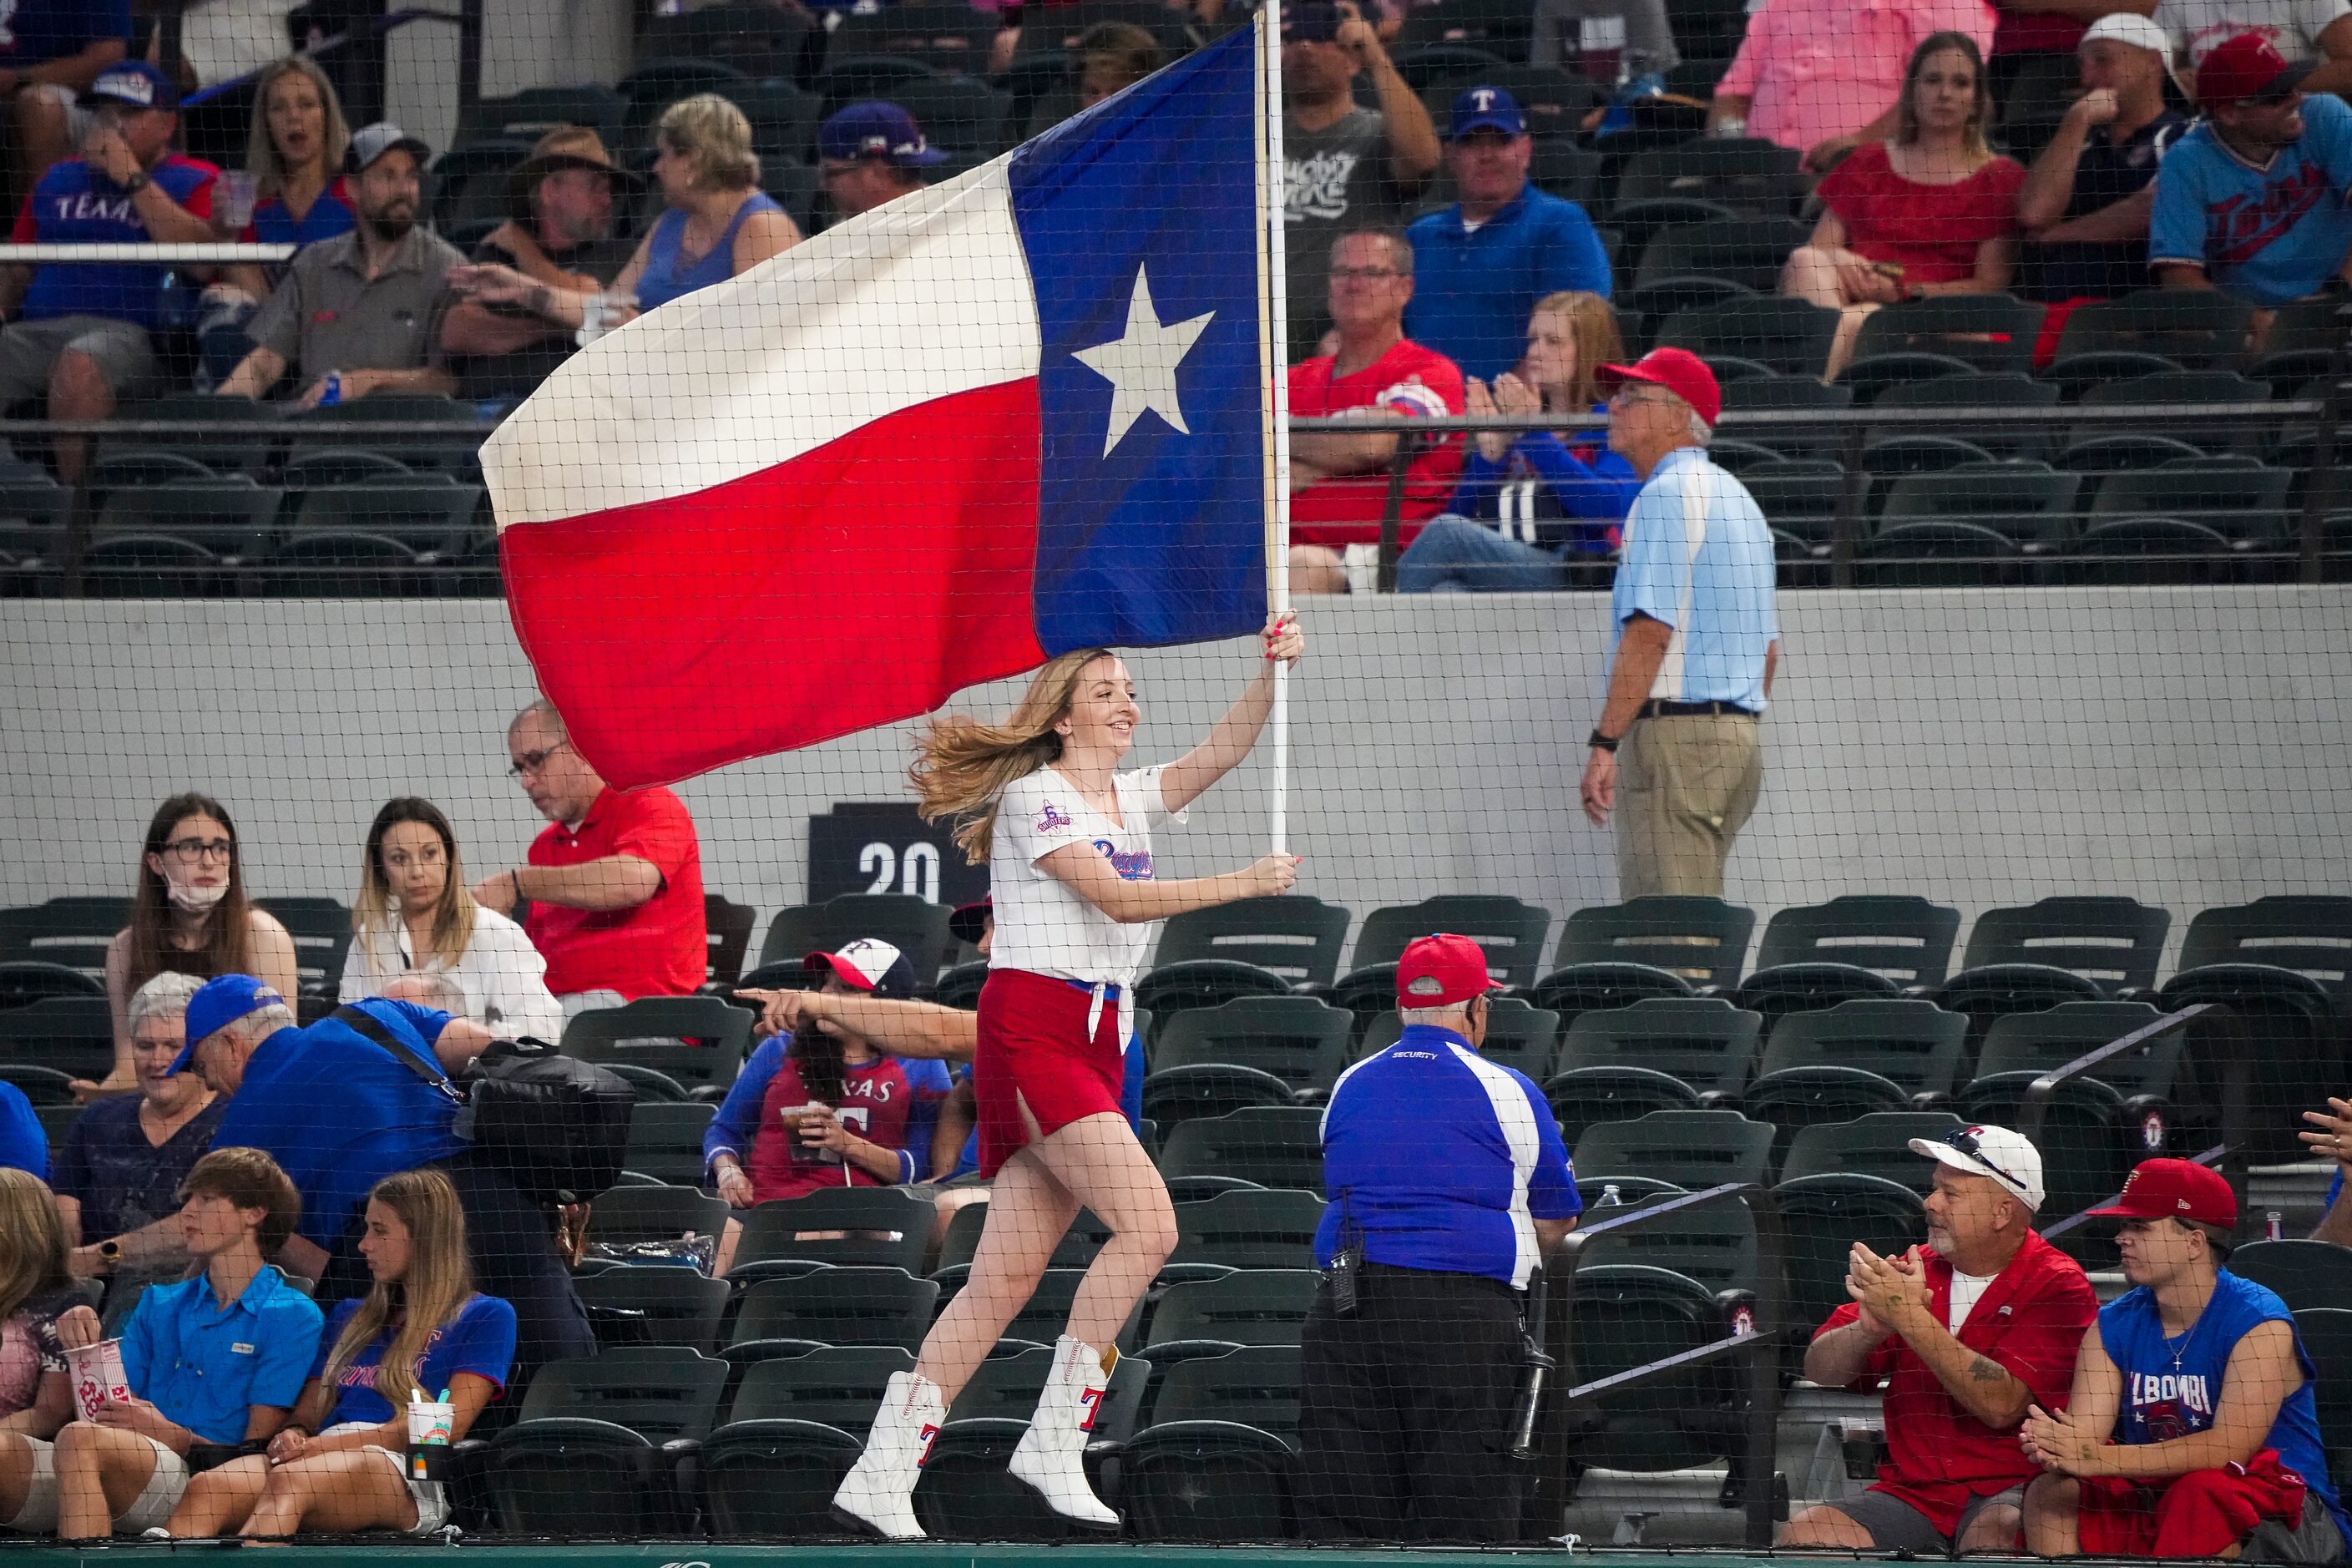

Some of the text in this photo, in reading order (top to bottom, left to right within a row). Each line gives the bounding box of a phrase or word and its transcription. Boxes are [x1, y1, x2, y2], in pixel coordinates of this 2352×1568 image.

[1472, 89, 1496, 111] T
[1038, 818, 1070, 832] SHOOTERS
[860, 842, 939, 903] 20
[1392, 1051, 1439, 1060] SECURITY
